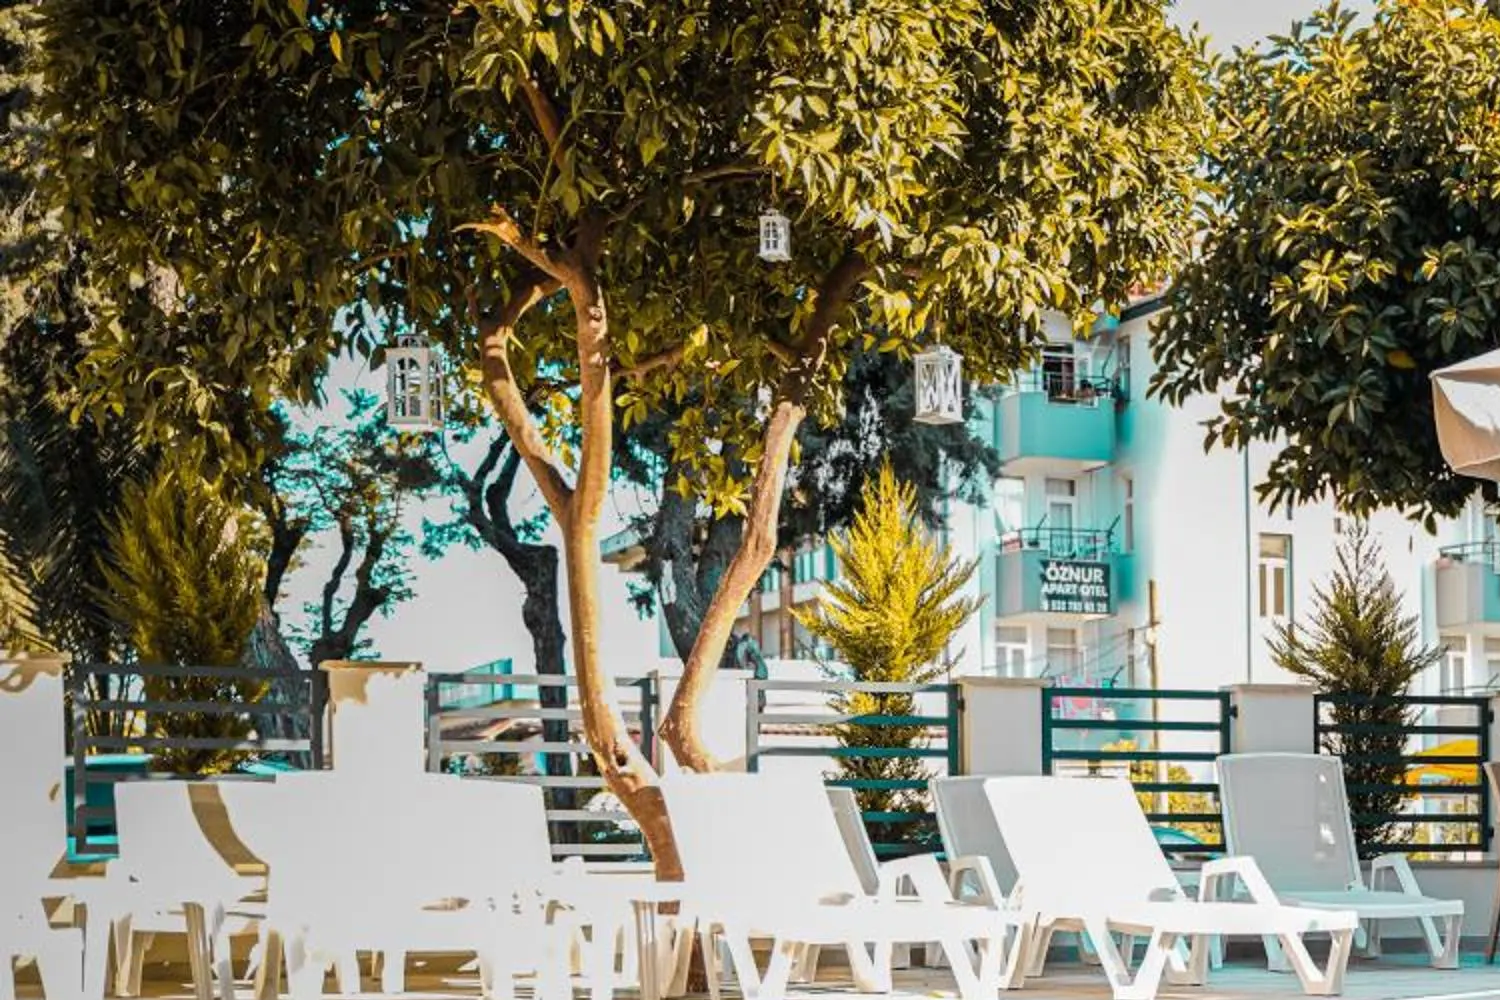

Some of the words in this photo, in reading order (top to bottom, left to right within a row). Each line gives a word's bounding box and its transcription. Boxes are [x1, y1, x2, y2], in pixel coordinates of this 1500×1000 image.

[1045, 562, 1105, 583] ÖZNUR
[1041, 583, 1077, 595] APART
[1079, 584, 1108, 597] OTEL
